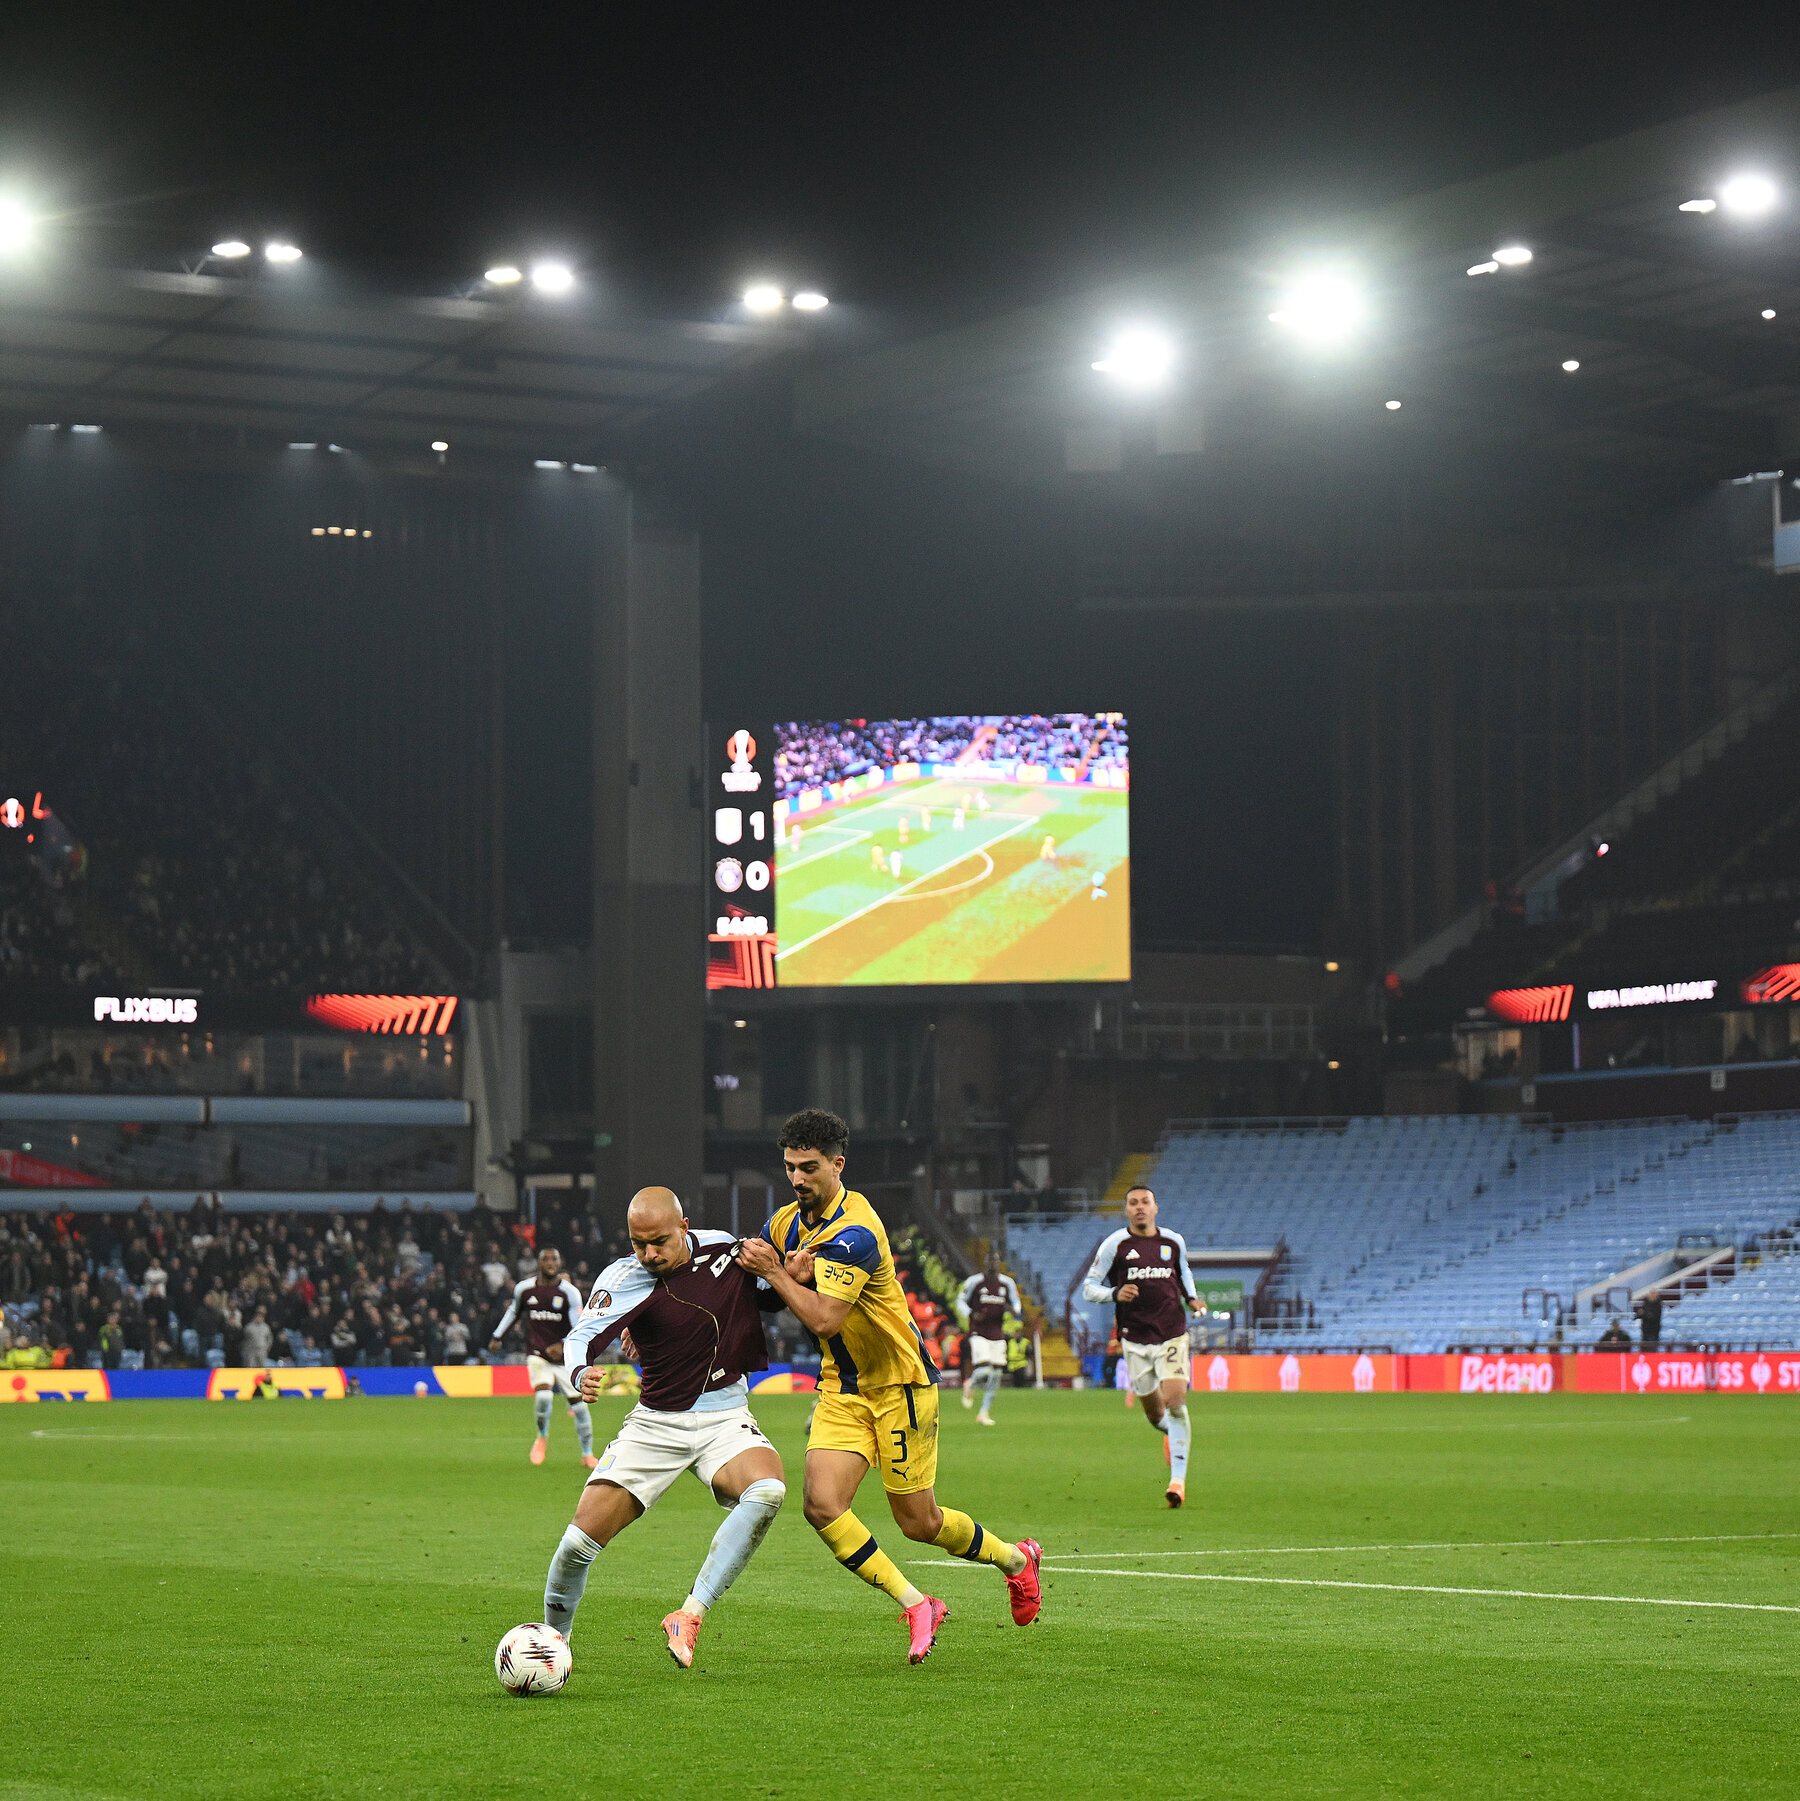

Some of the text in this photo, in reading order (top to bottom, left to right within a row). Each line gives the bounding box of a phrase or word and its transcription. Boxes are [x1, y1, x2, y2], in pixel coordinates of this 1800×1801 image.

[749, 811, 765, 841] 1
[745, 860, 770, 891] 0
[823, 1264, 855, 1286] BYD
[1127, 1267, 1172, 1280] Betano
[1460, 1356, 1553, 1393] Betano
[1657, 1361, 1744, 1388] STRAUSS
[890, 1430, 908, 1463] 3
